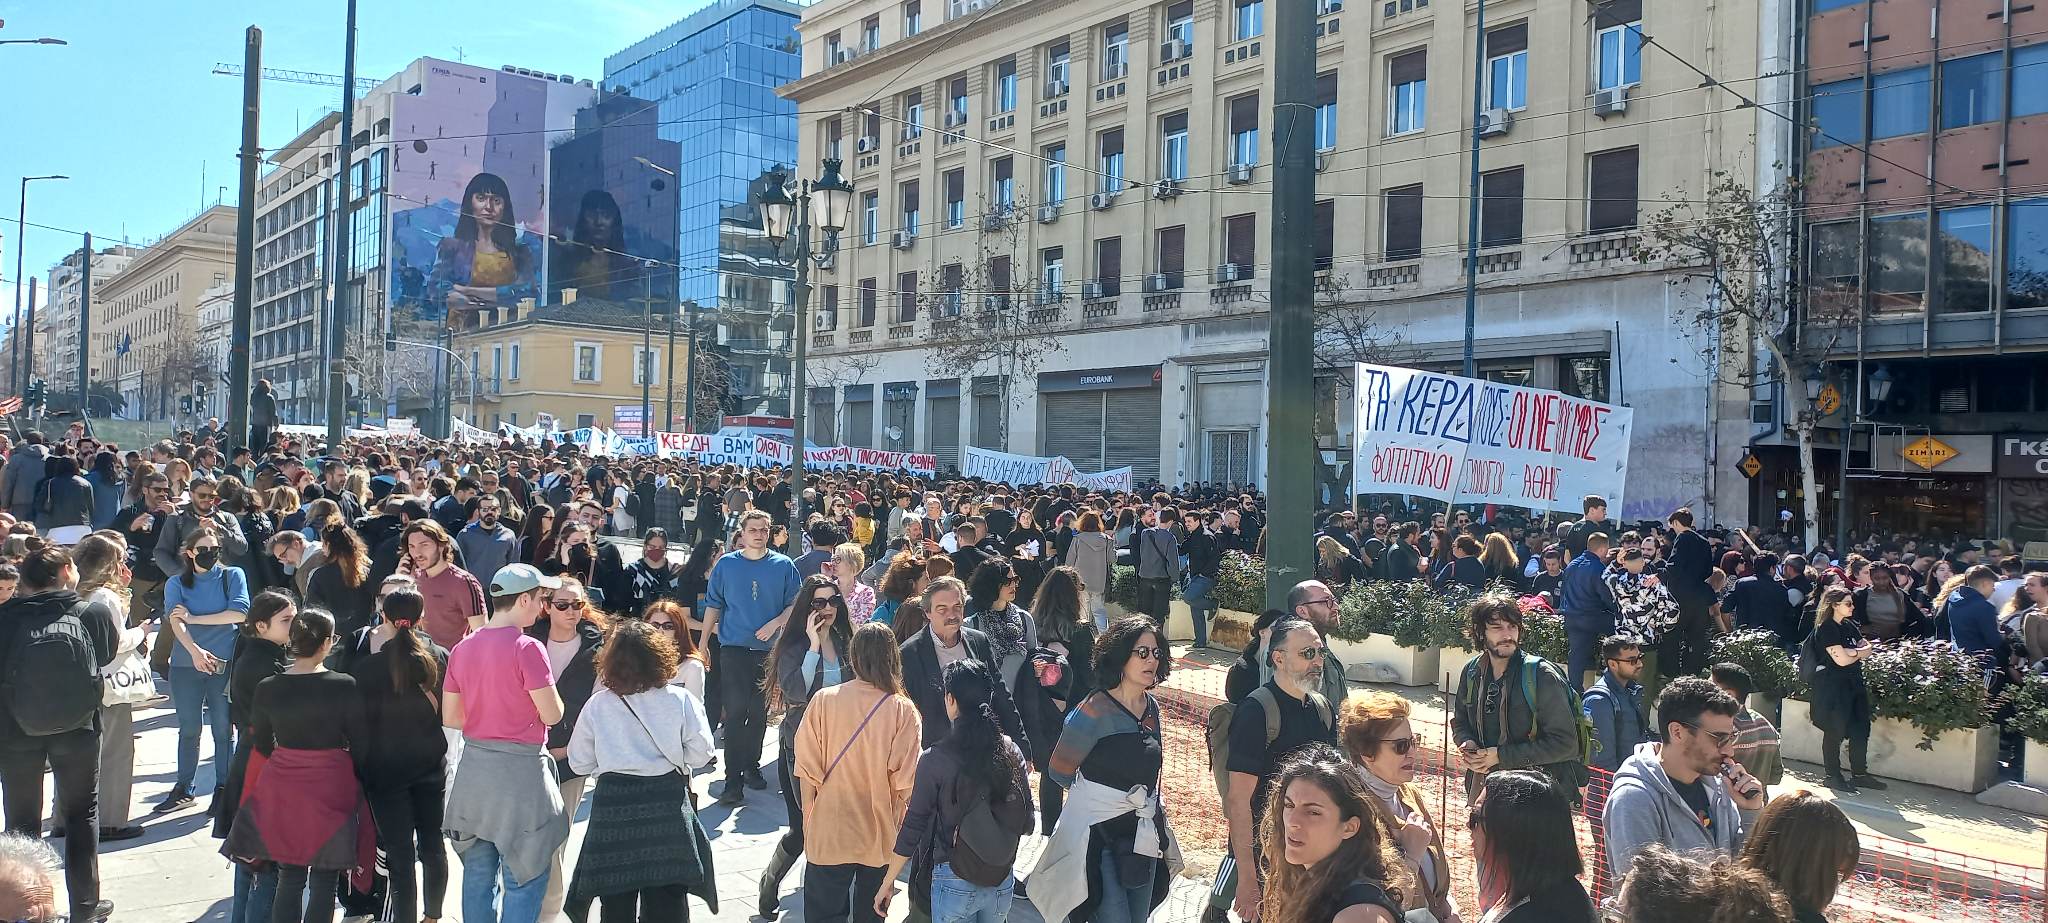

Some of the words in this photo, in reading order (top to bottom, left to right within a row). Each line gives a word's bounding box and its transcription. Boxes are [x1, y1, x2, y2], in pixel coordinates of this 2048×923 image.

[1080, 375, 1114, 385] EUROBANK
[1366, 369, 1391, 432] ΤΑ
[1567, 403, 1612, 462] ΜΑΣ
[661, 433, 711, 453] ΚΕΡΔΗ
[1371, 443, 1453, 492] ΦΟΙΤΗΤΙΚΟΙ
